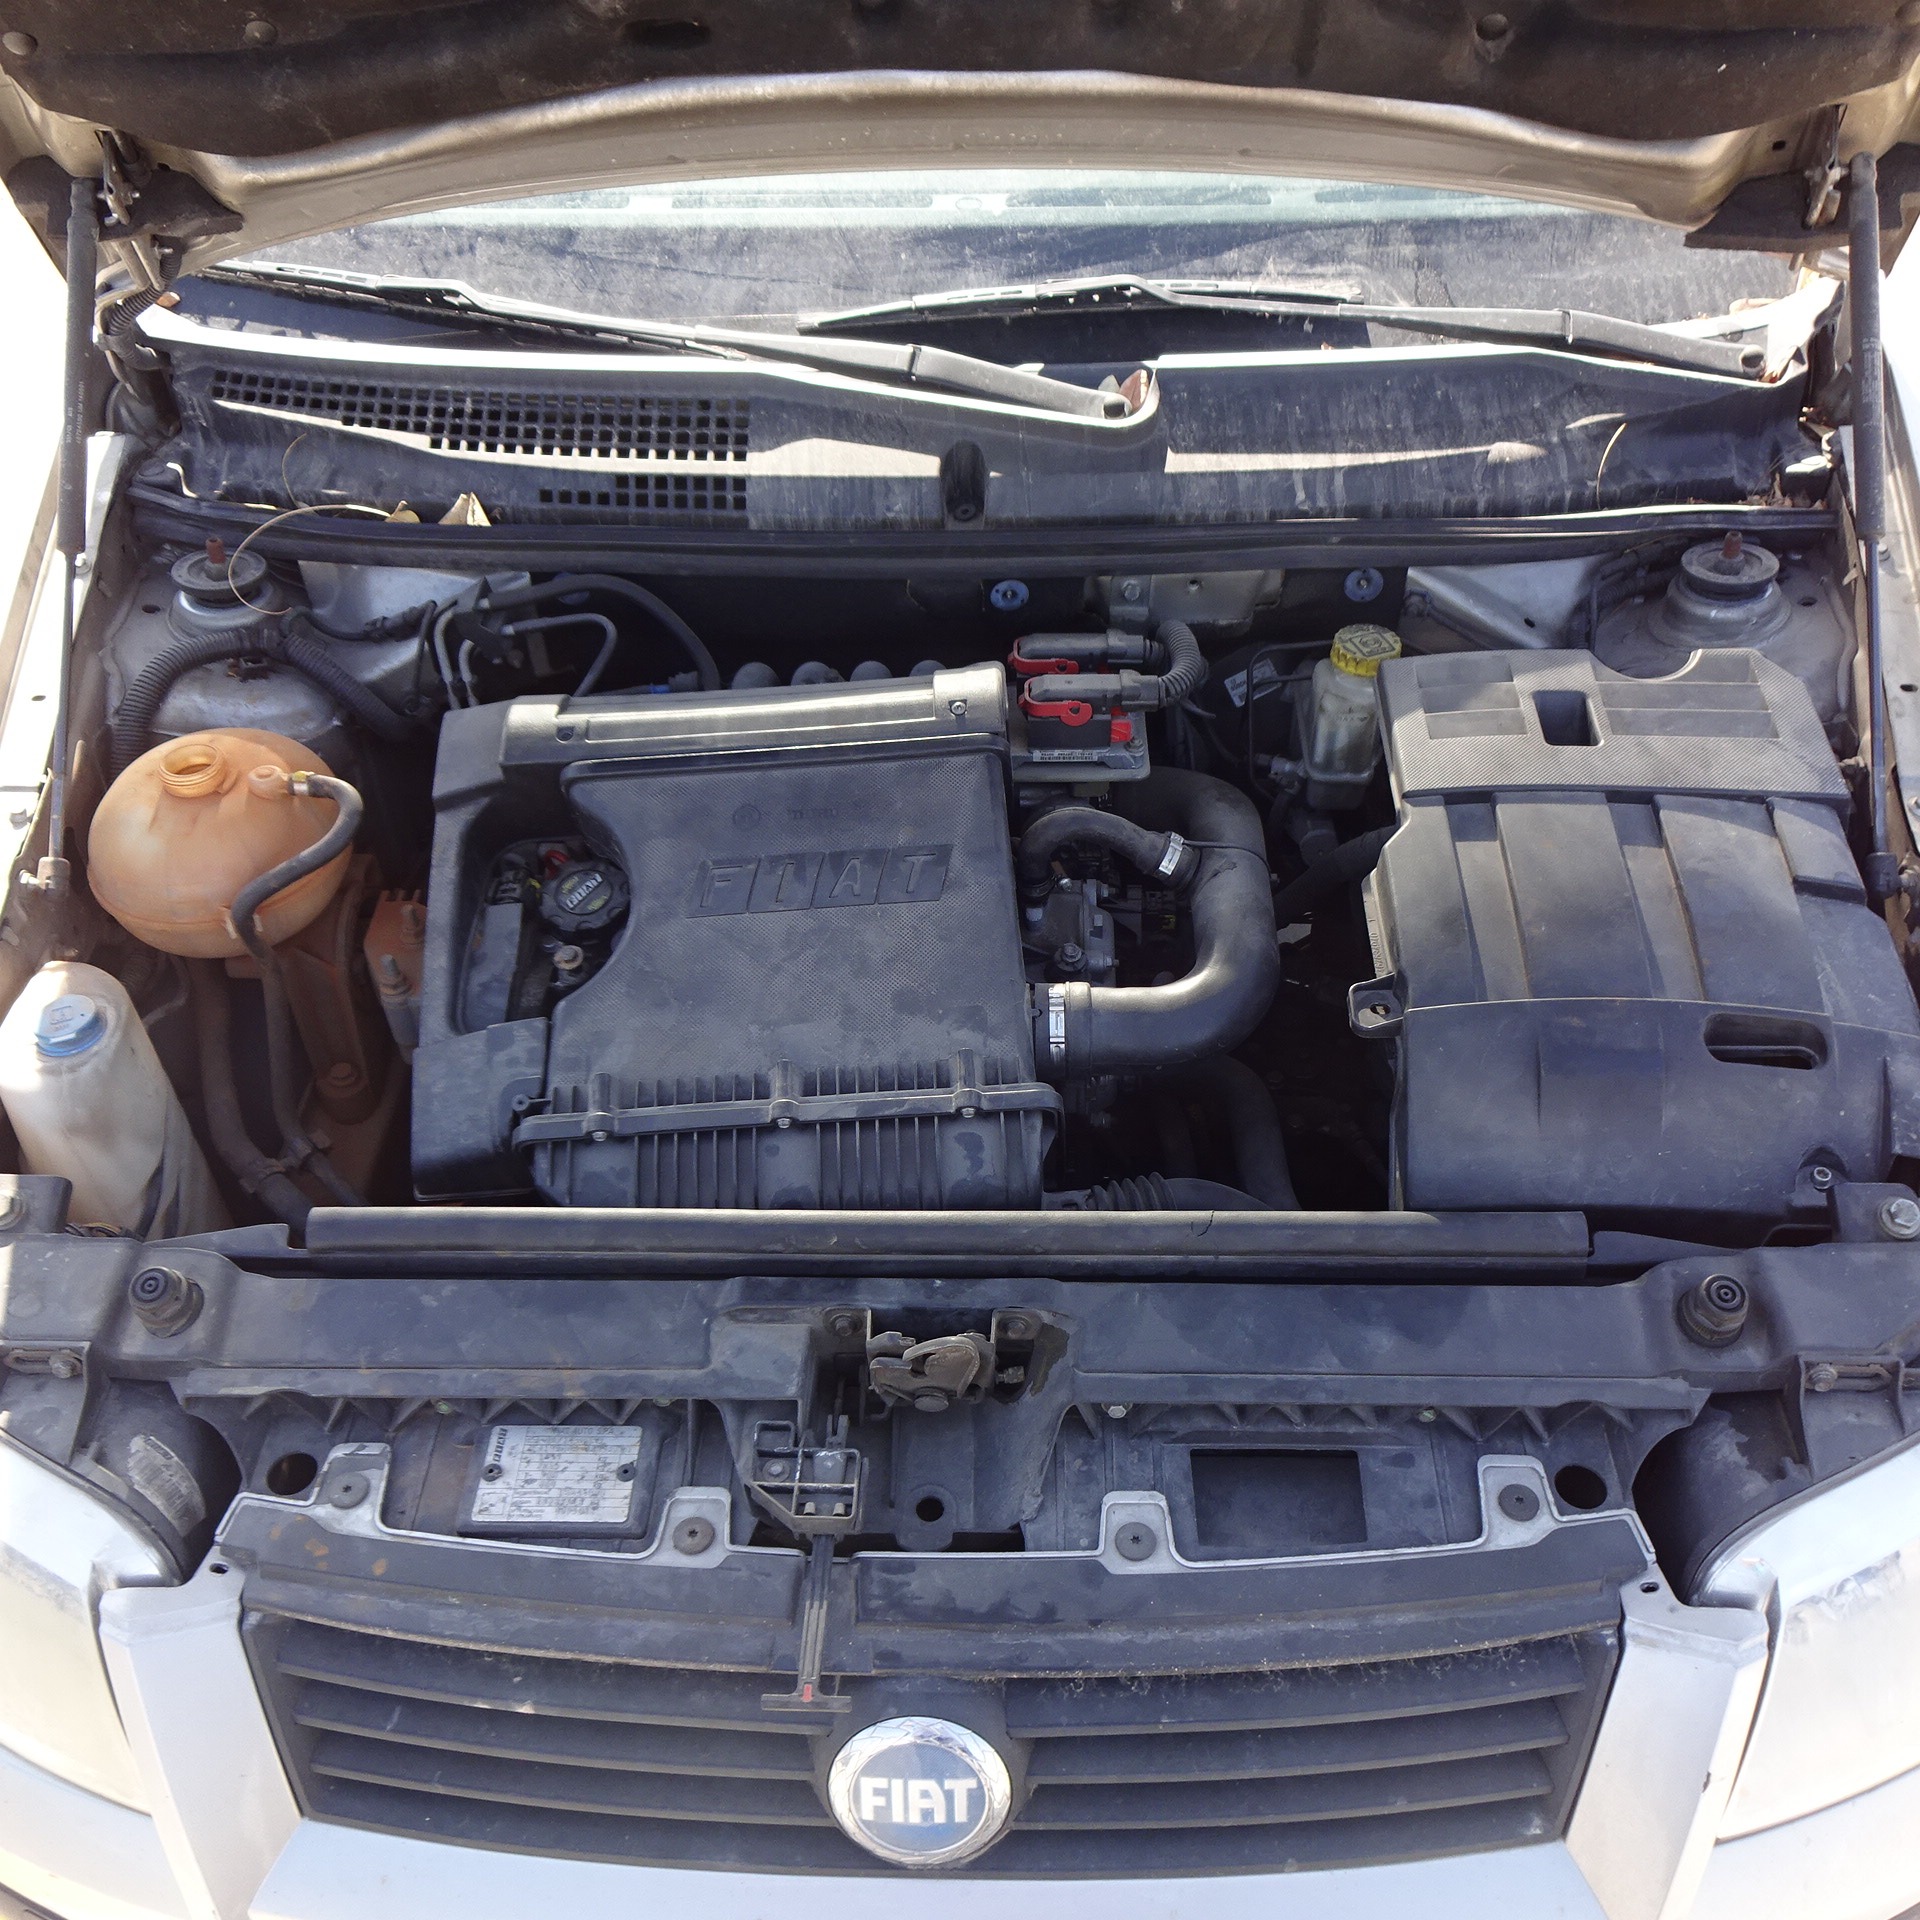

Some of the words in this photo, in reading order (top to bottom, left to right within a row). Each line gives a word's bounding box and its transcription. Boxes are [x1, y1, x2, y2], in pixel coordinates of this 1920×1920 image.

[566, 873, 603, 909] FIAT
[699, 852, 938, 908] FIAT
[860, 1776, 978, 1824] FIAT
